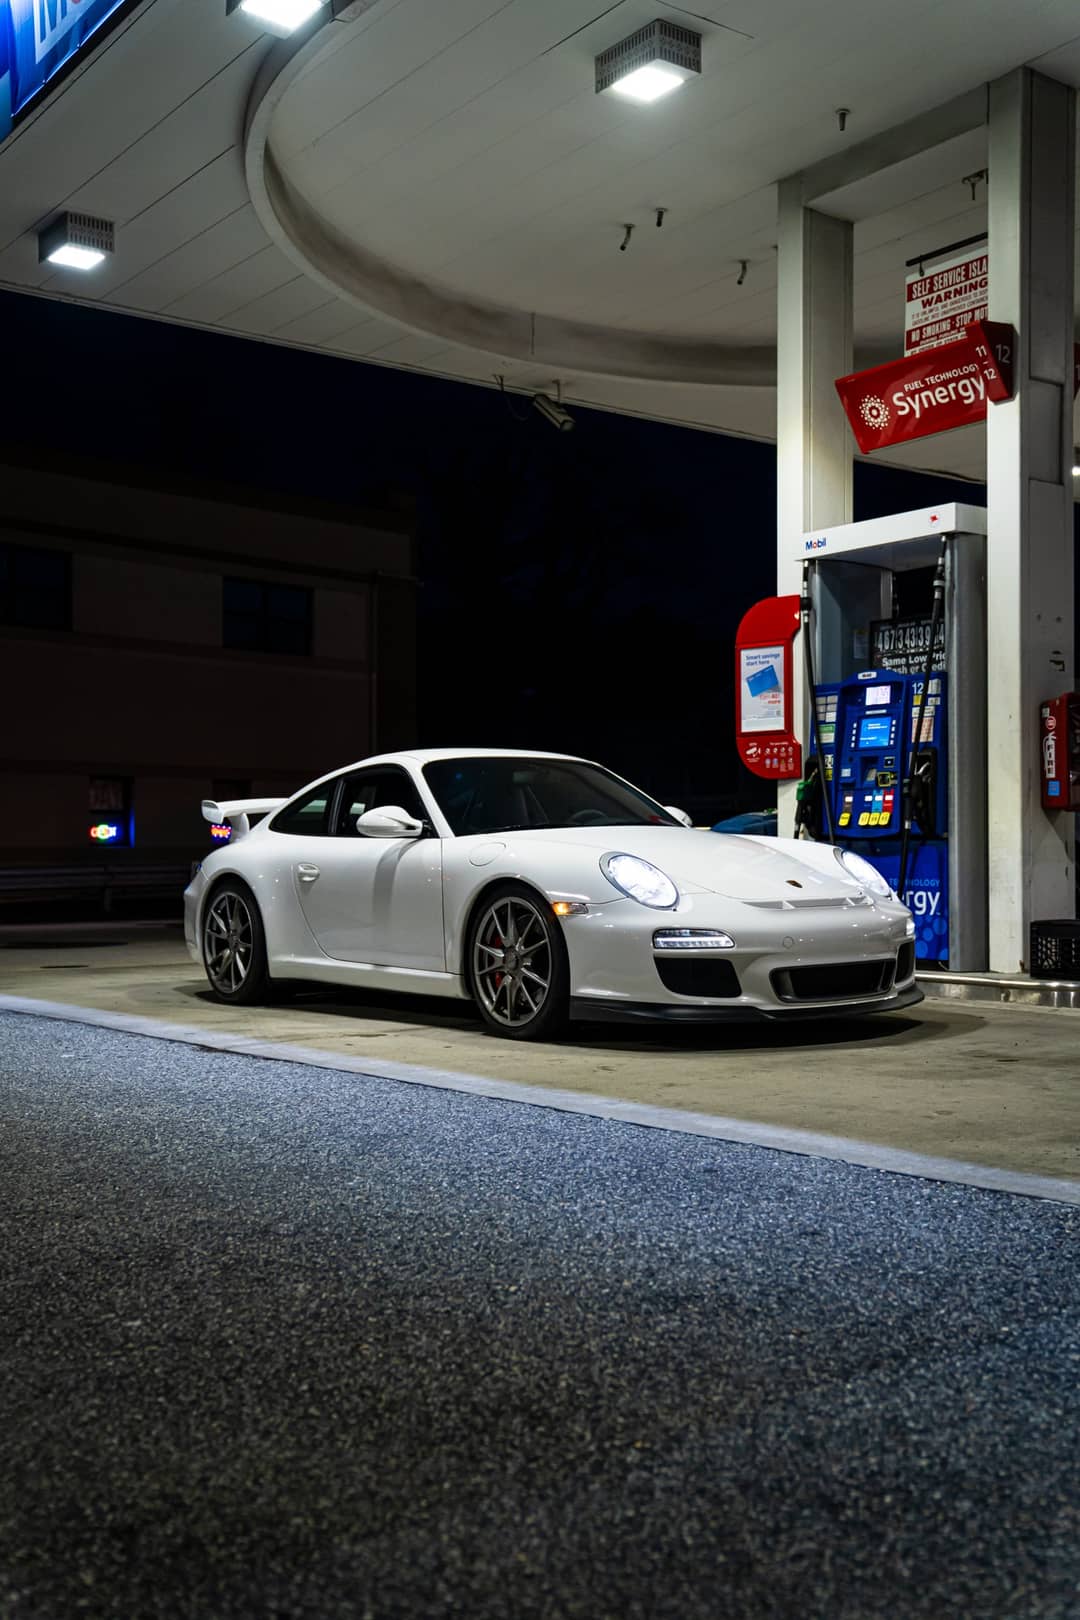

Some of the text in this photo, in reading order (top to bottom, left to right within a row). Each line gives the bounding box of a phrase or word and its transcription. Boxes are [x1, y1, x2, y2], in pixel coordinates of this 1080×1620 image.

[911, 259, 987, 299] SELF SERVICE ISLA
[921, 277, 988, 309] WARNING
[910, 329, 920, 343] NO
[922, 319, 951, 339] SMOKING
[955, 311, 972, 327] STOP
[975, 345, 987, 358] 11
[995, 343, 1010, 364] 12
[983, 368, 997, 381] 12
[904, 382, 925, 392] FUEL
[892, 375, 985, 418] Synergy
[805, 537, 827, 550] Mobil
[882, 657, 906, 668] Same
[908, 654, 928, 664] Low
[912, 682, 924, 694] 12
